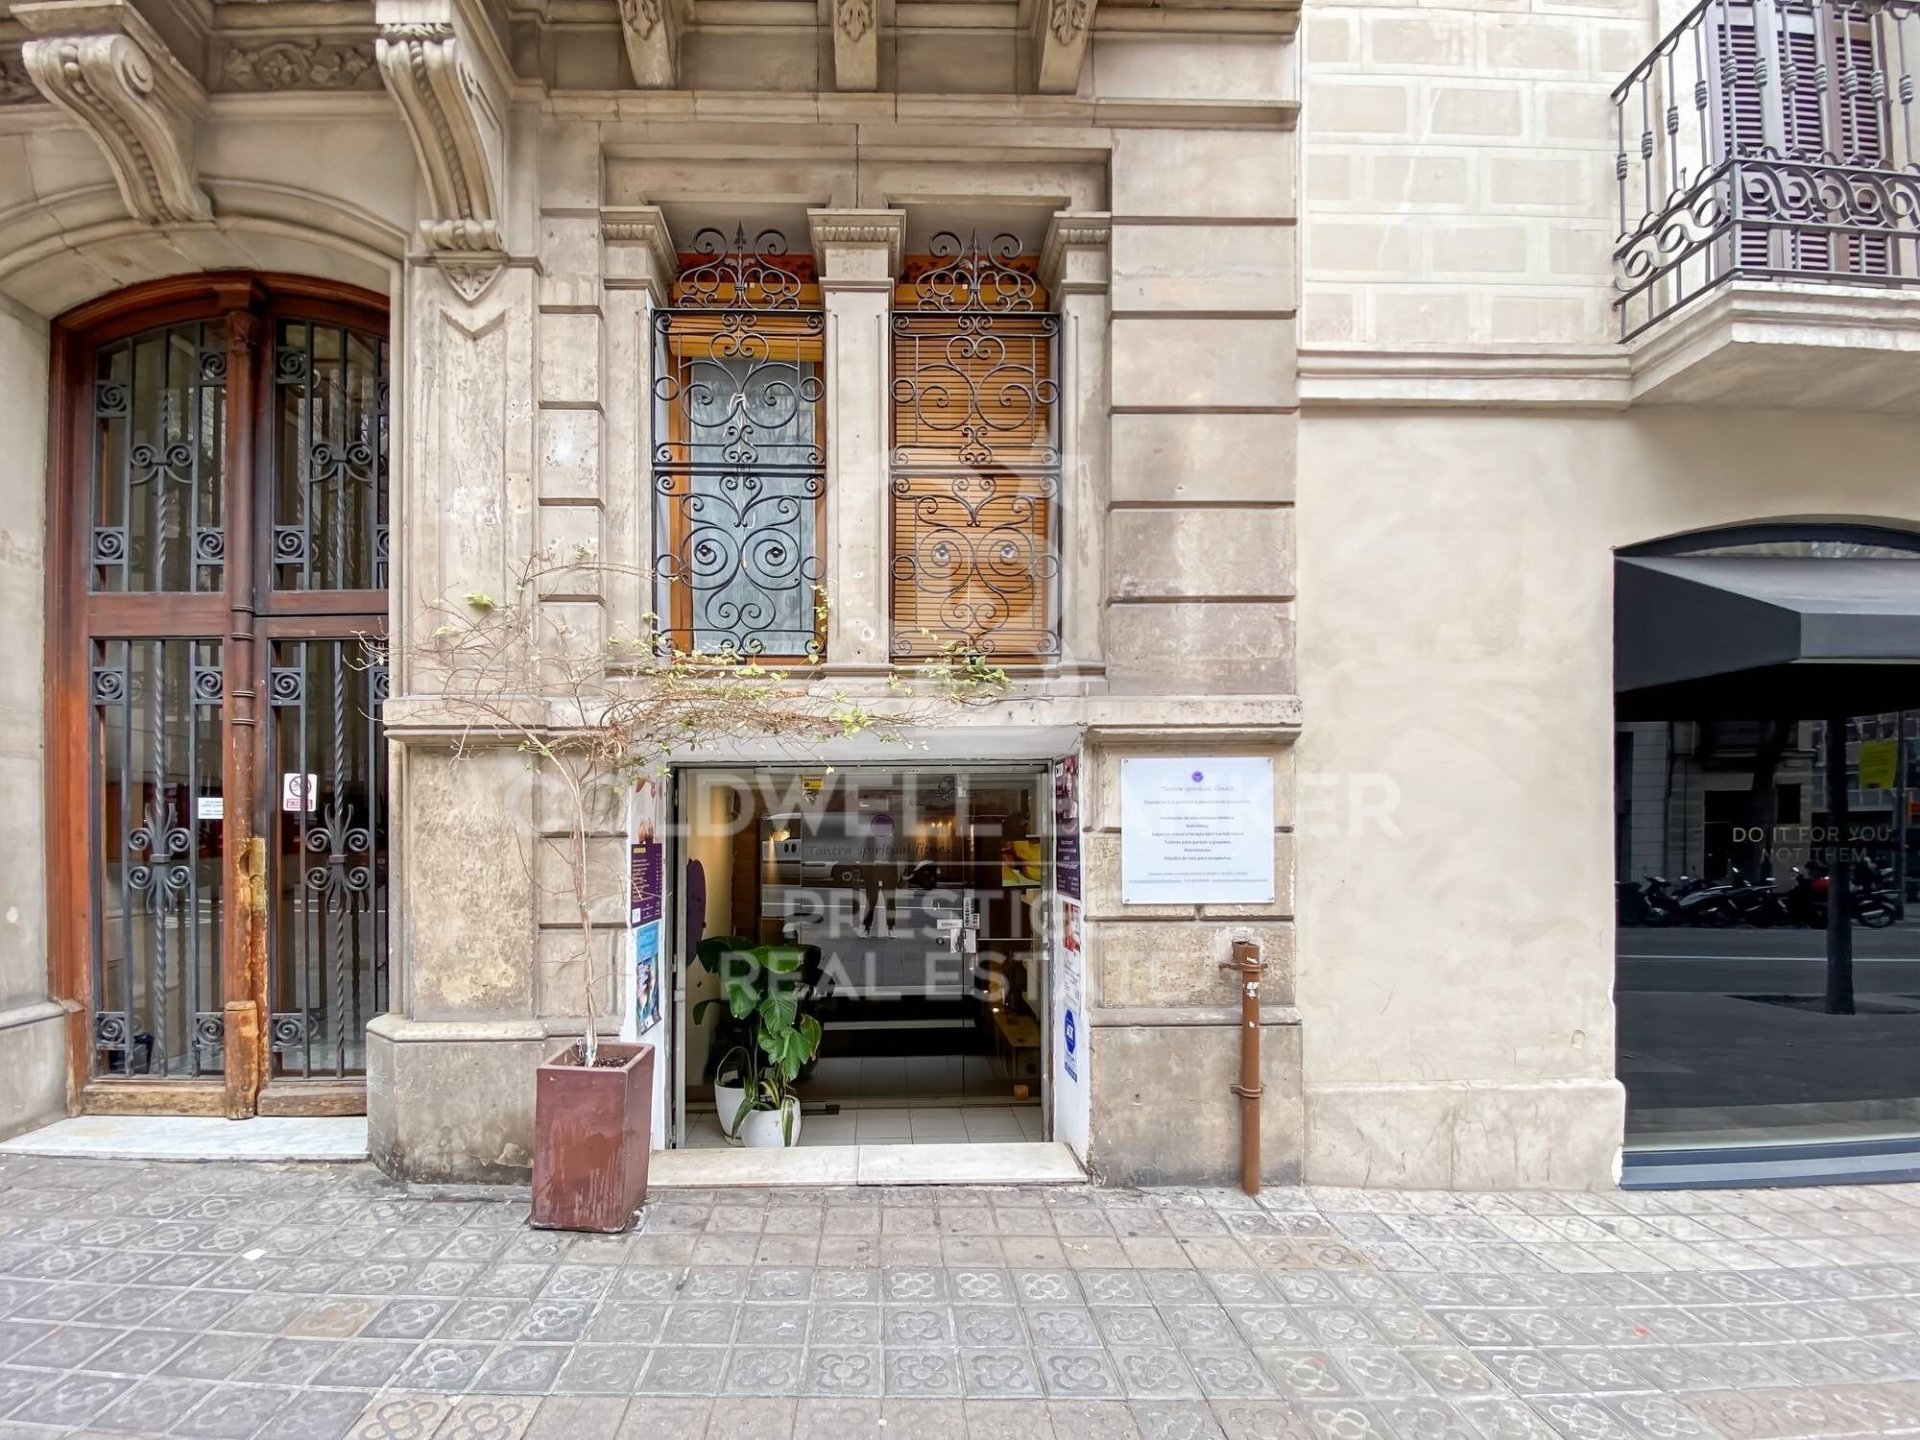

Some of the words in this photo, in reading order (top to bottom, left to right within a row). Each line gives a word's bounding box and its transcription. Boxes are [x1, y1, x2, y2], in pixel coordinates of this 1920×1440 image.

[1732, 827, 1764, 843] DO
[1773, 826, 1791, 843] IT
[1798, 826, 1840, 843] FOR
[808, 845, 852, 857] Tantra
[854, 842, 912, 860] spiritual
[1761, 847, 1803, 863] NOT
[1811, 847, 1867, 863] THEM
